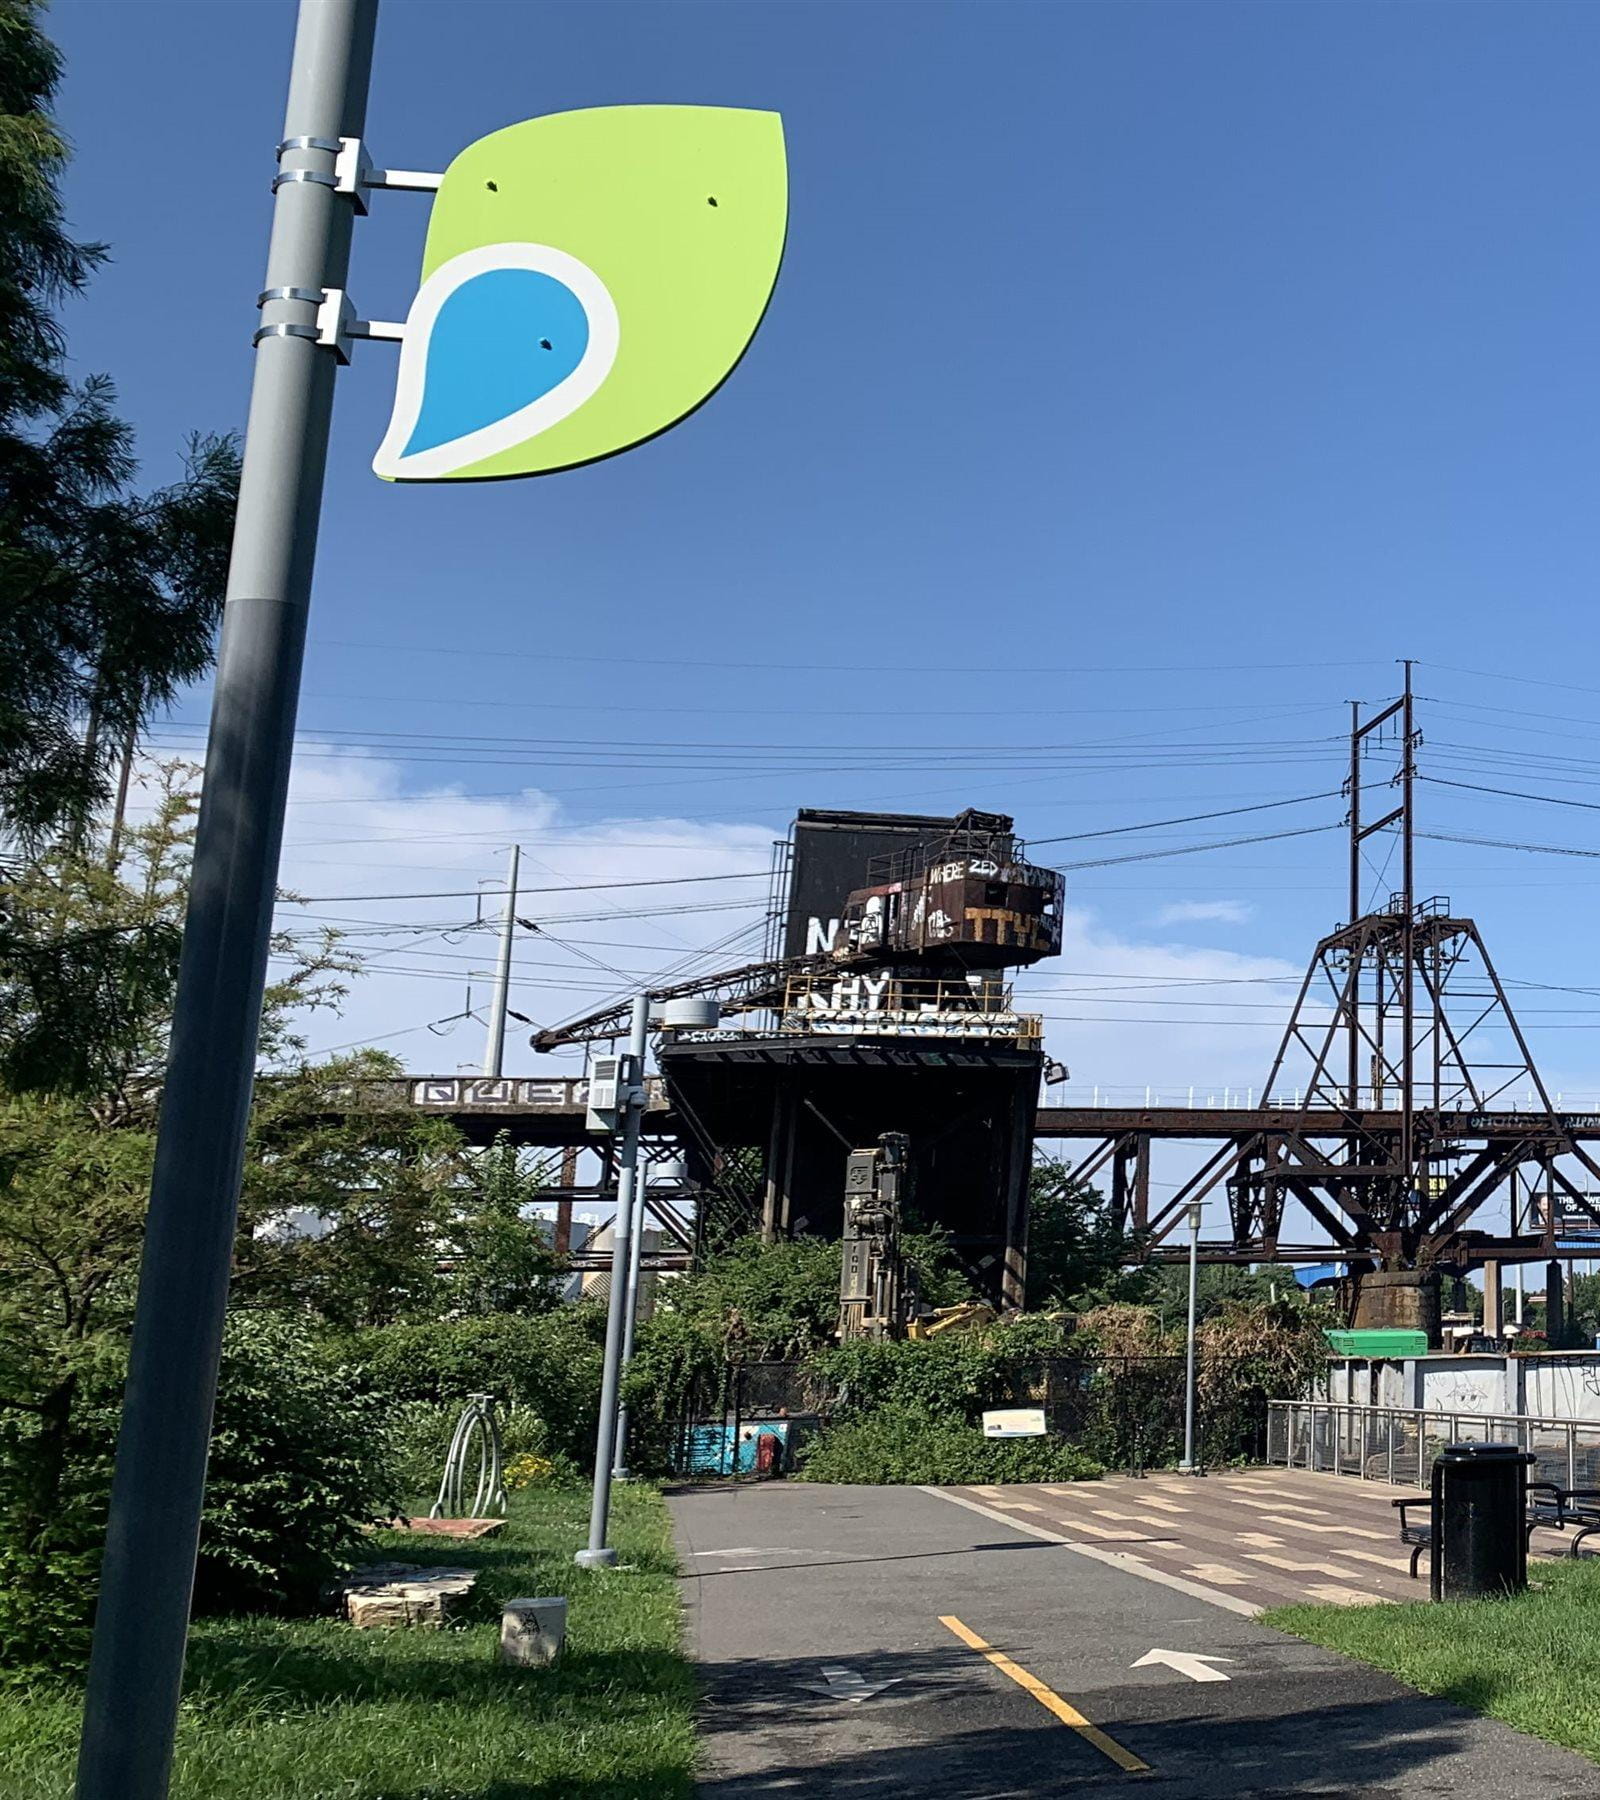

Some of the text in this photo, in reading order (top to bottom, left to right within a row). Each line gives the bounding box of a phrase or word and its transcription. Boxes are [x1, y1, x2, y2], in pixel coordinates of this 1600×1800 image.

[930, 861, 965, 884] WHERE
[968, 859, 999, 877] ZED
[1565, 1204, 1577, 1212] OF
